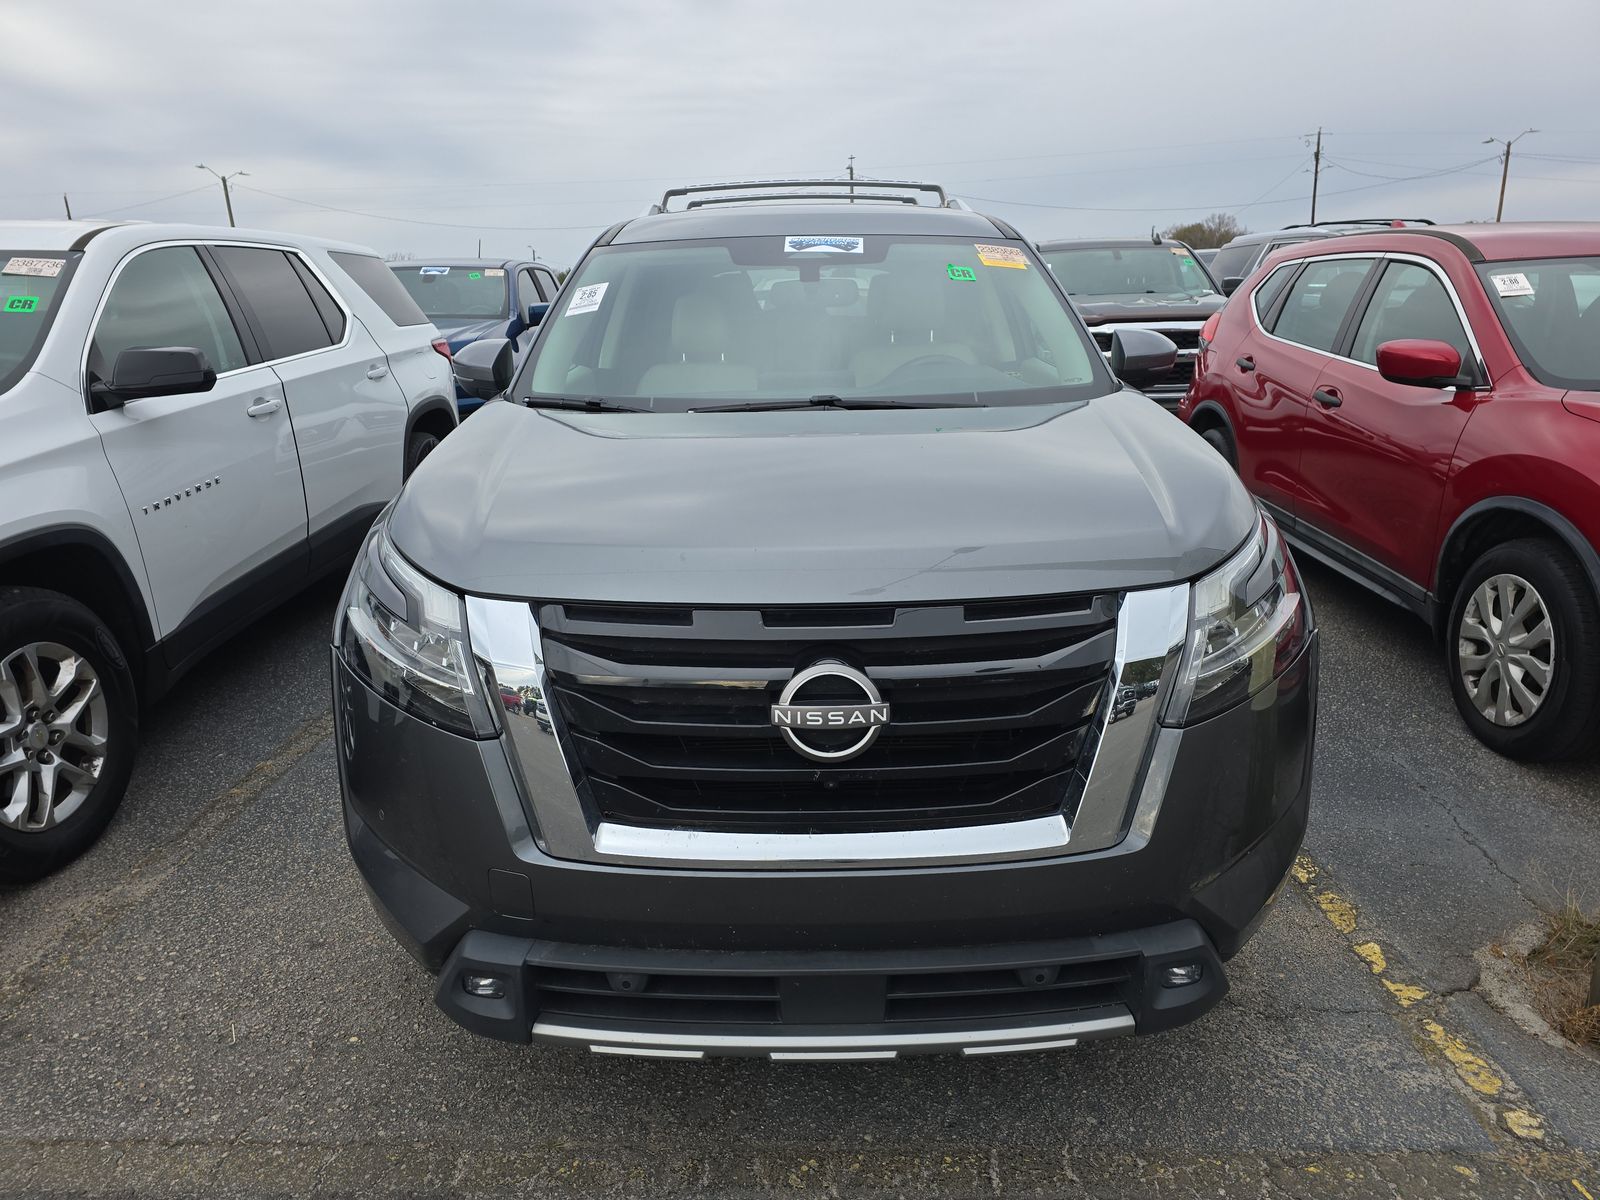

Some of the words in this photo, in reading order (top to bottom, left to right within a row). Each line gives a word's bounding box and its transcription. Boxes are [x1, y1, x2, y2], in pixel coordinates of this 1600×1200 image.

[950, 268, 973, 278] CR
[8, 299, 35, 309] CR
[142, 475, 221, 515] TRAVERSE
[774, 707, 888, 726] NISSAN
